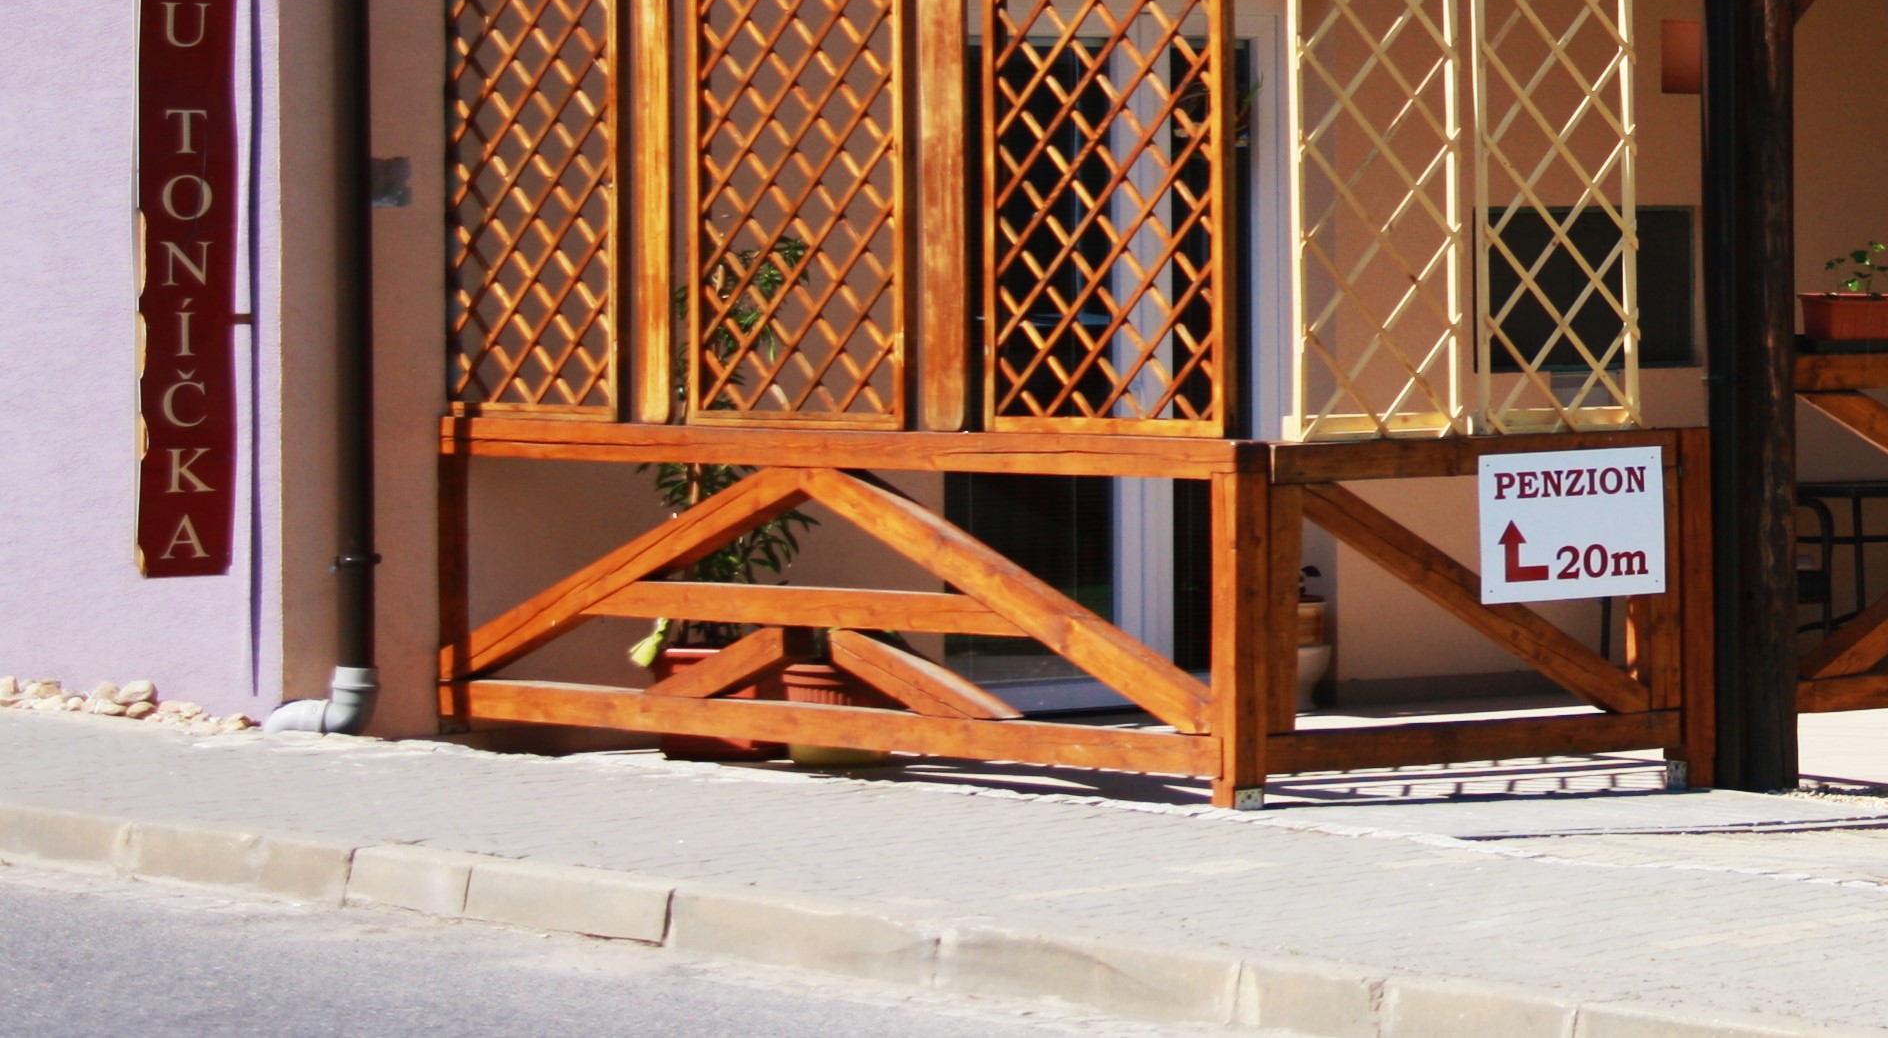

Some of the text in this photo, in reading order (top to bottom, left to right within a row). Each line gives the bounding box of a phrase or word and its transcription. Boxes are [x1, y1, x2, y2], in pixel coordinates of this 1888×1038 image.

[161, 1, 211, 48] U
[160, 108, 216, 560] TONÍČKA
[1493, 465, 1647, 500] PENZION
[1555, 543, 1649, 580] 20m
